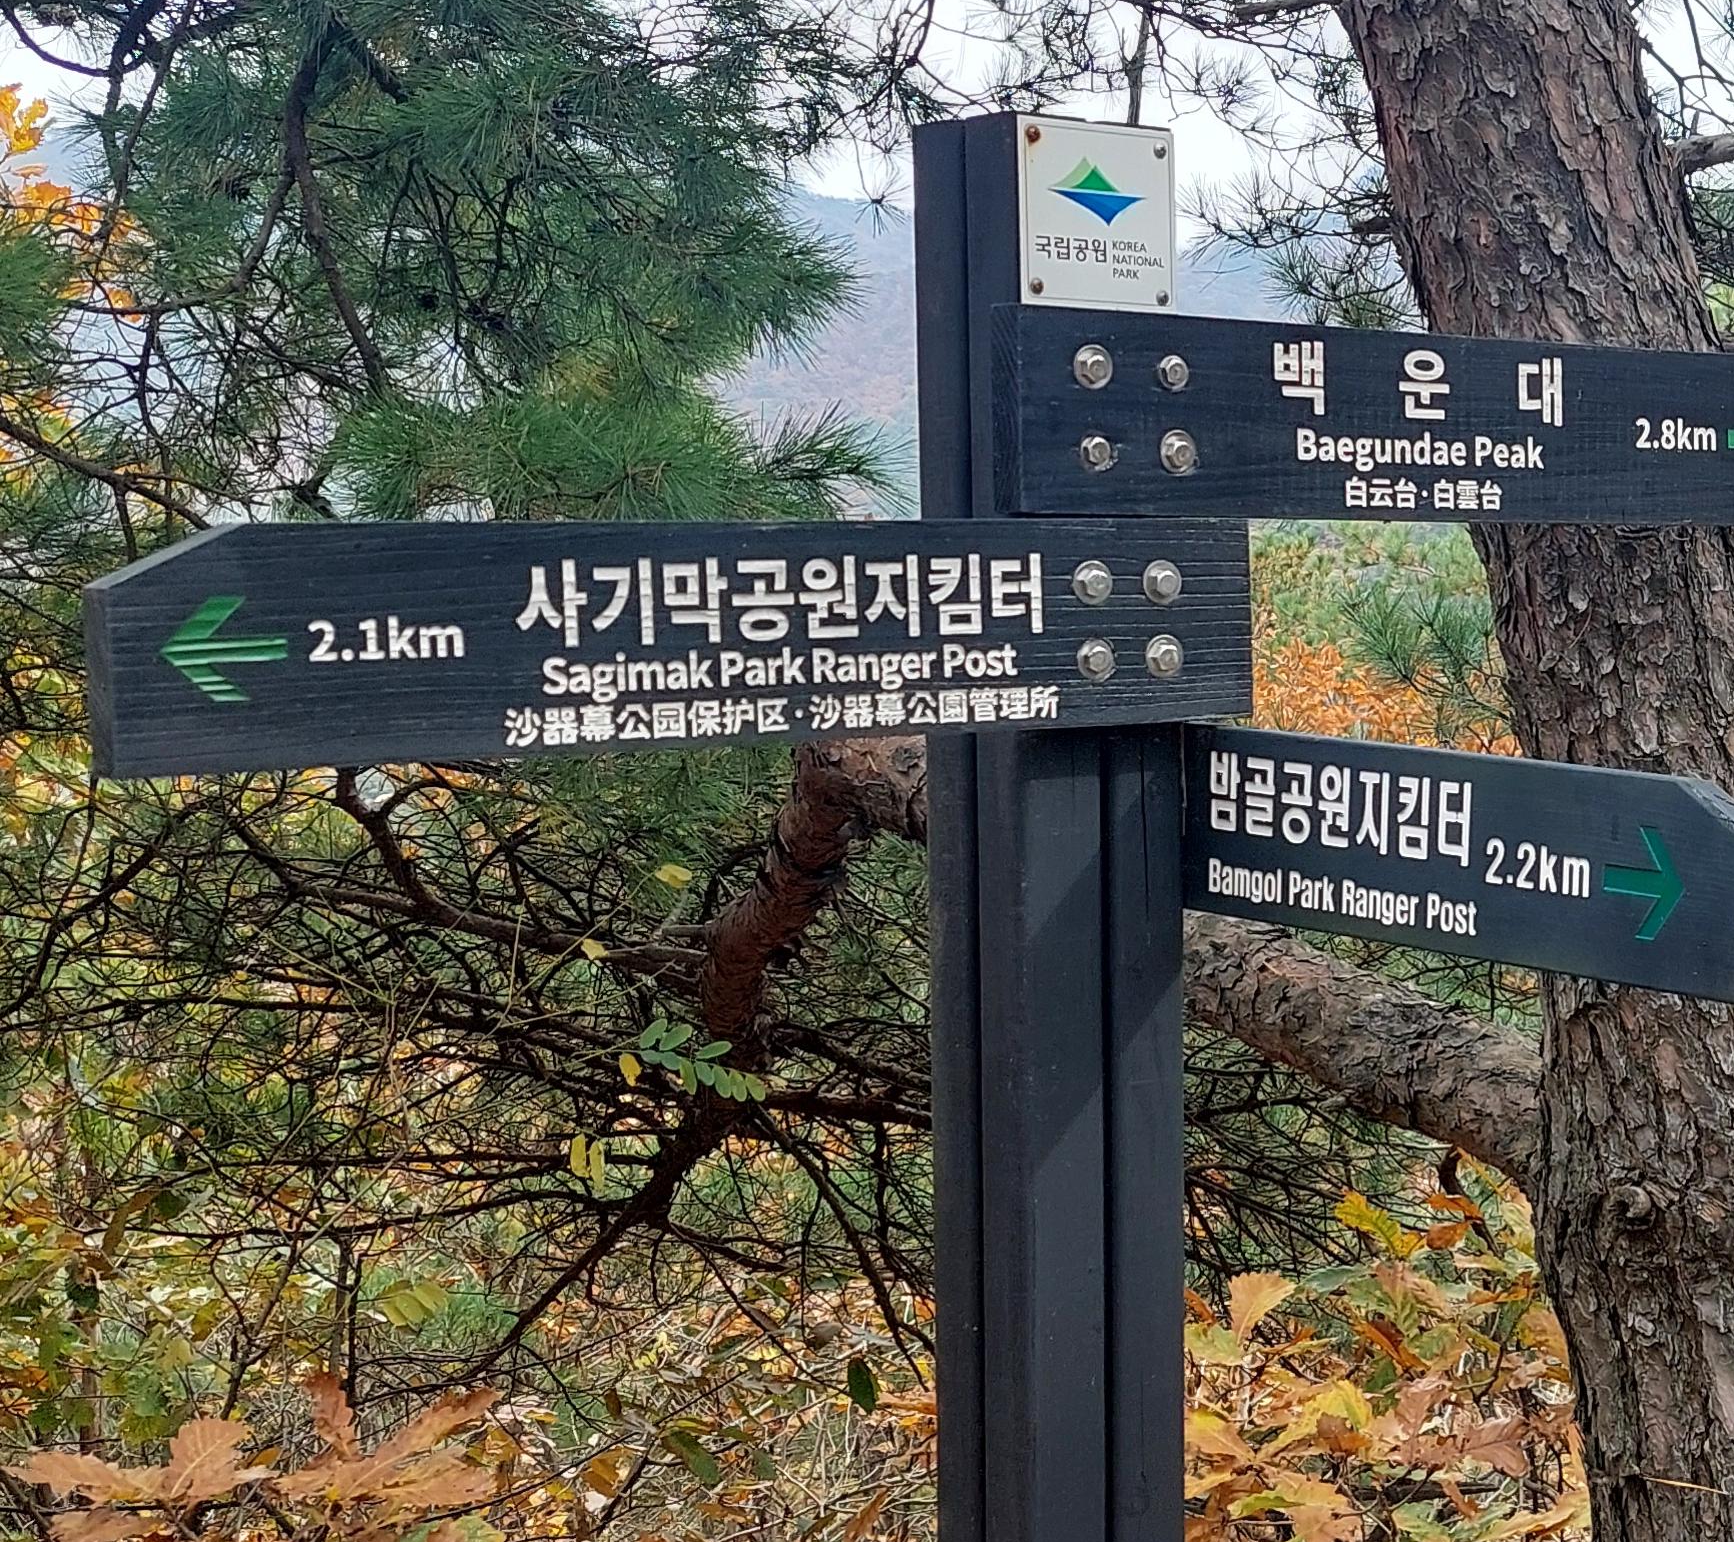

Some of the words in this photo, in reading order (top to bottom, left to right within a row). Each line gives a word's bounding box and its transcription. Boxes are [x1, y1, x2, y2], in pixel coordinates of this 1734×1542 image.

[1034, 234, 1108, 264] 국립공원
[1111, 240, 1148, 254] KOREA
[1111, 253, 1165, 269] NATIONAL
[1112, 267, 1140, 280] PARK
[1296, 427, 1468, 472] Baegundae
[1474, 435, 1545, 470] Peak
[1635, 417, 1718, 452] 2.8km
[515, 553, 1044, 648] 사기막공원지킴터
[306, 615, 466, 663] 2.1km
[541, 649, 715, 703] Sagimak
[720, 646, 806, 687] Park
[812, 651, 943, 692] Ranger
[943, 642, 1018, 679] Post
[1208, 750, 1474, 868] 밤골공원지킴터
[1484, 837, 1591, 898] 2.2km
[1207, 857, 1283, 906] Bamgol
[1288, 870, 1336, 913] Park
[1340, 882, 1420, 927] Ranger
[1426, 893, 1478, 937] Post
